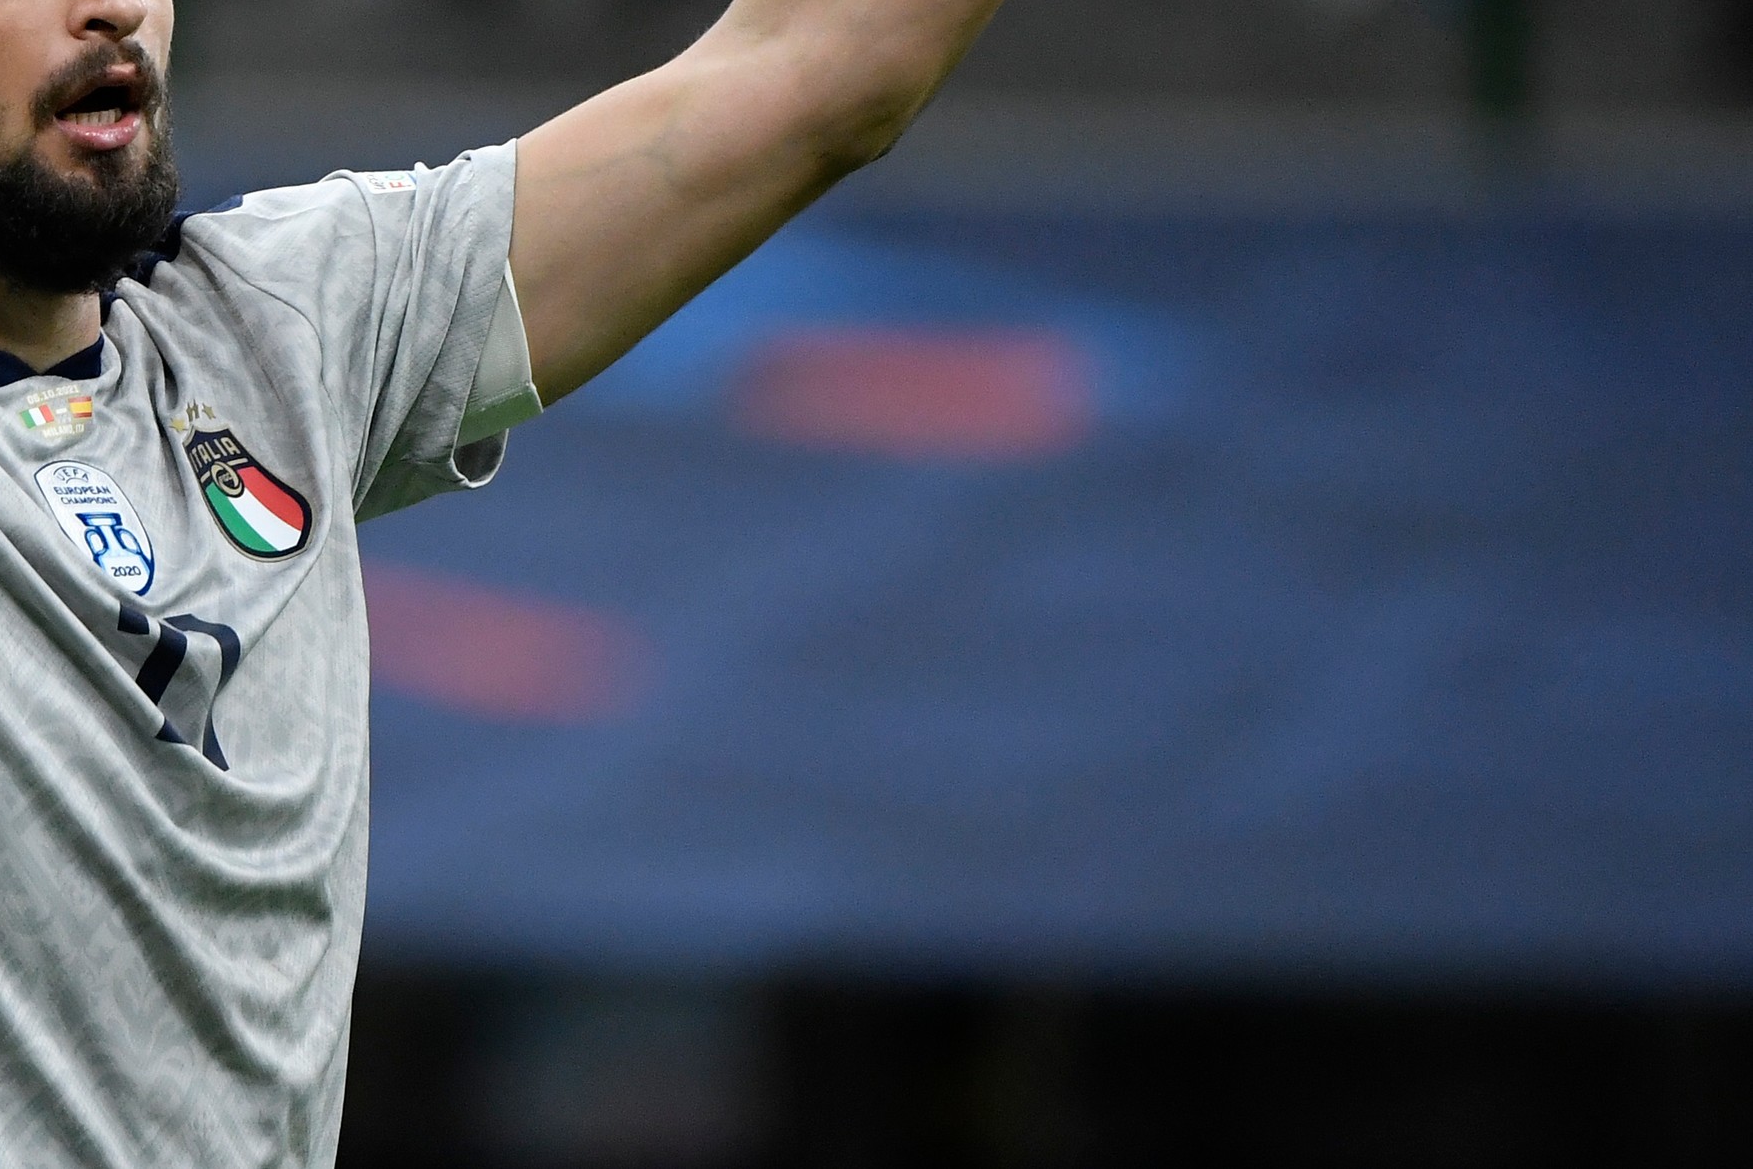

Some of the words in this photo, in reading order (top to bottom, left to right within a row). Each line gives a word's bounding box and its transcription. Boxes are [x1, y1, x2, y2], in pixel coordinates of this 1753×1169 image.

[189, 437, 241, 472] ITALIA
[56, 469, 89, 482] UEFA
[53, 486, 111, 495] EUROPEAN
[60, 497, 117, 505] CHAMPIONS
[111, 565, 141, 577] 2020
